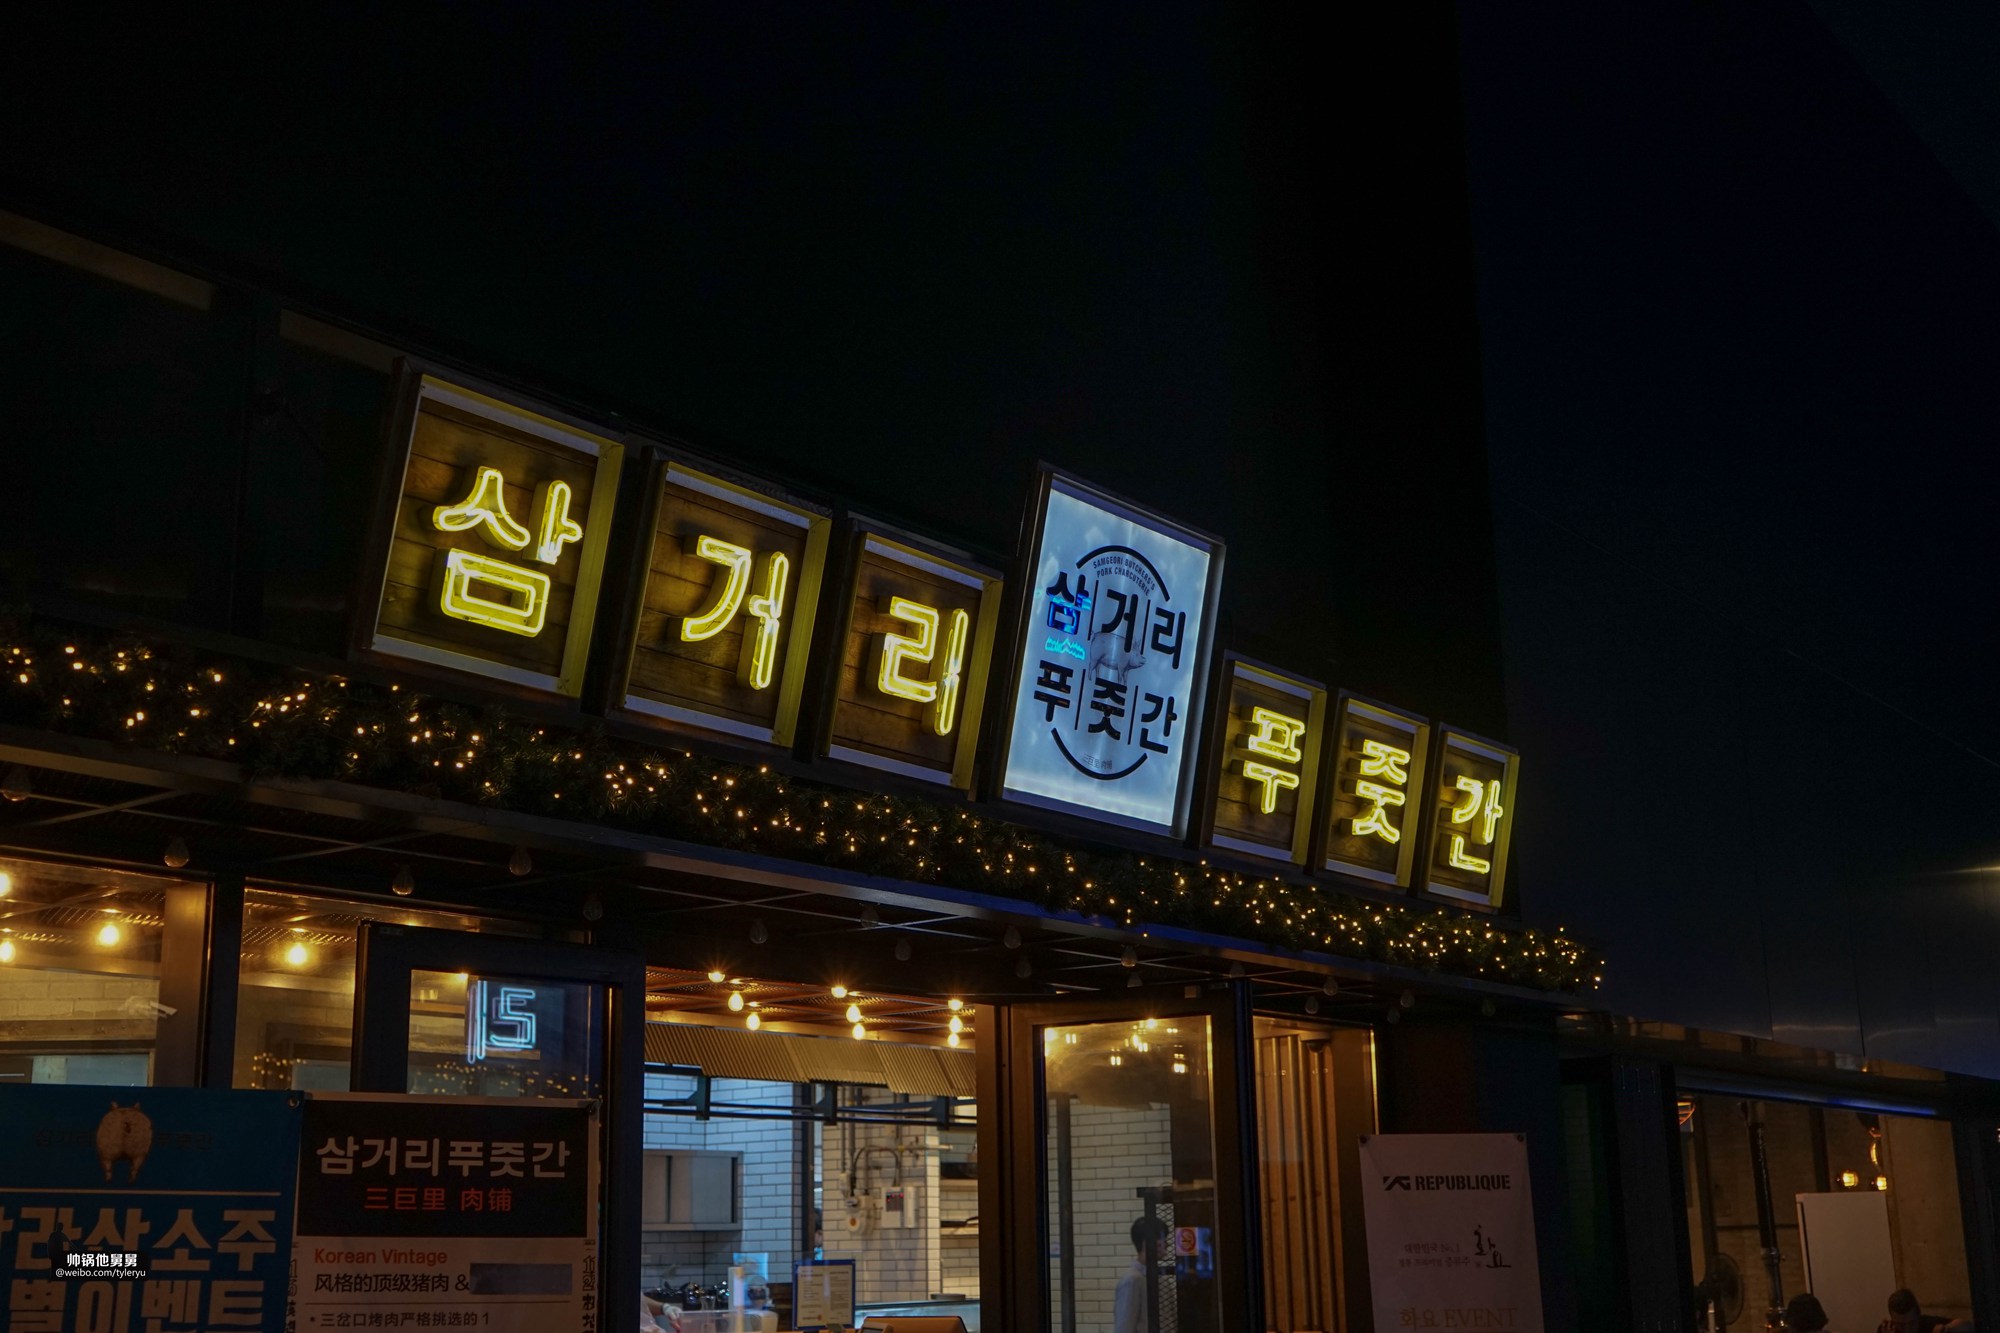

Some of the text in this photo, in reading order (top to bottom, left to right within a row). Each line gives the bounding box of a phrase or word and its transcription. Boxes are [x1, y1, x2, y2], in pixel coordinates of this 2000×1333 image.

[1093, 556, 1123, 569] SAMGEORI
[1097, 567, 1150, 596] PORK CHARCUTERIE
[433, 466, 968, 736] 삼거리
[1046, 572, 1186, 670] 삼거리
[1033, 660, 1178, 755] 푸줏간
[1242, 706, 1504, 875] 푸줏간
[316, 1136, 571, 1179] 삼거리푸줏간
[1416, 1175, 1511, 1191] REPUBLIQUE
[363, 1186, 513, 1212] 三巨里 肉铺
[315, 1248, 447, 1266] Korean Vintage
[314, 1273, 449, 1293] 风格的顶级猪肉
[320, 1312, 478, 1328] 三岔口烤肉严格挑选的
[1400, 1308, 1517, 1330] 화요 EVENT
